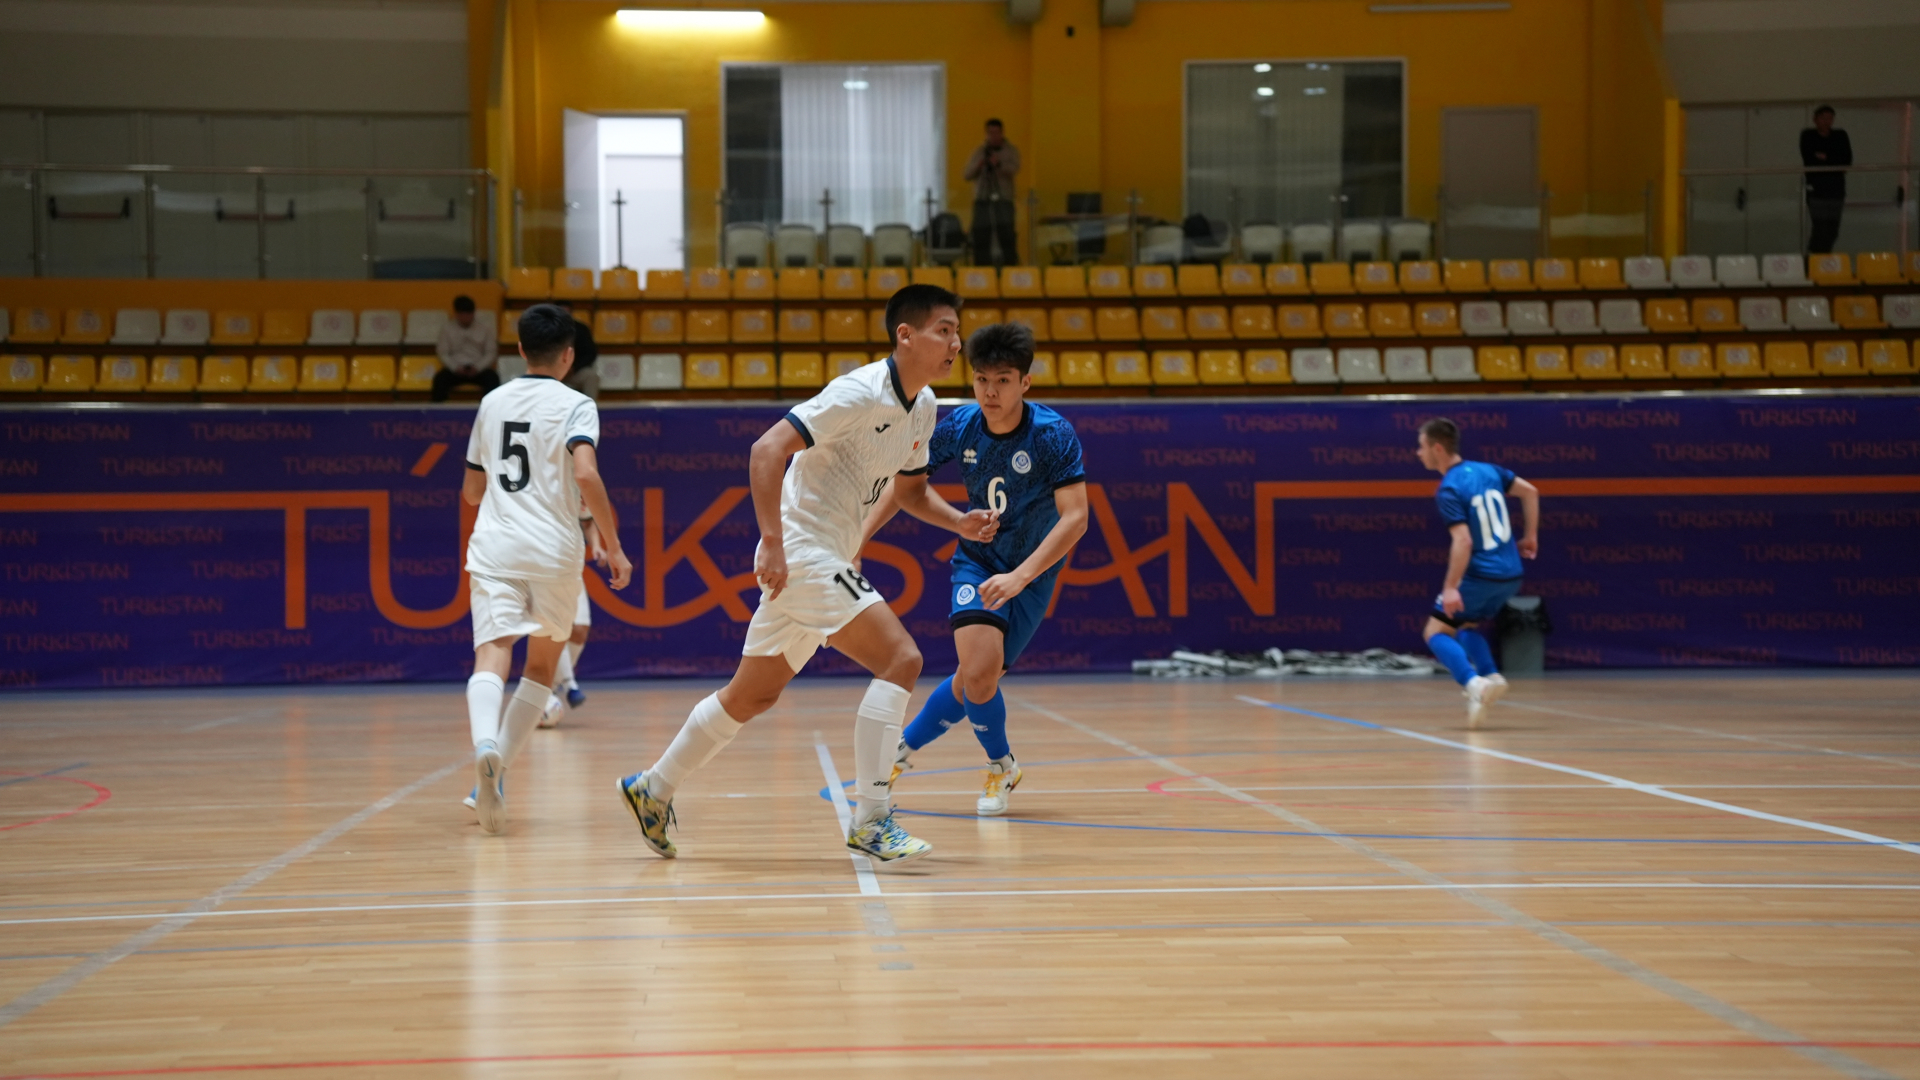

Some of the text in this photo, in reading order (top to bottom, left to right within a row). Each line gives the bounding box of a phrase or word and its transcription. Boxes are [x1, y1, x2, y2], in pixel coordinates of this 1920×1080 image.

[498, 422, 531, 493] 5
[987, 476, 1007, 515] 6
[1470, 488, 1511, 551] 10
[834, 567, 875, 602] 18
